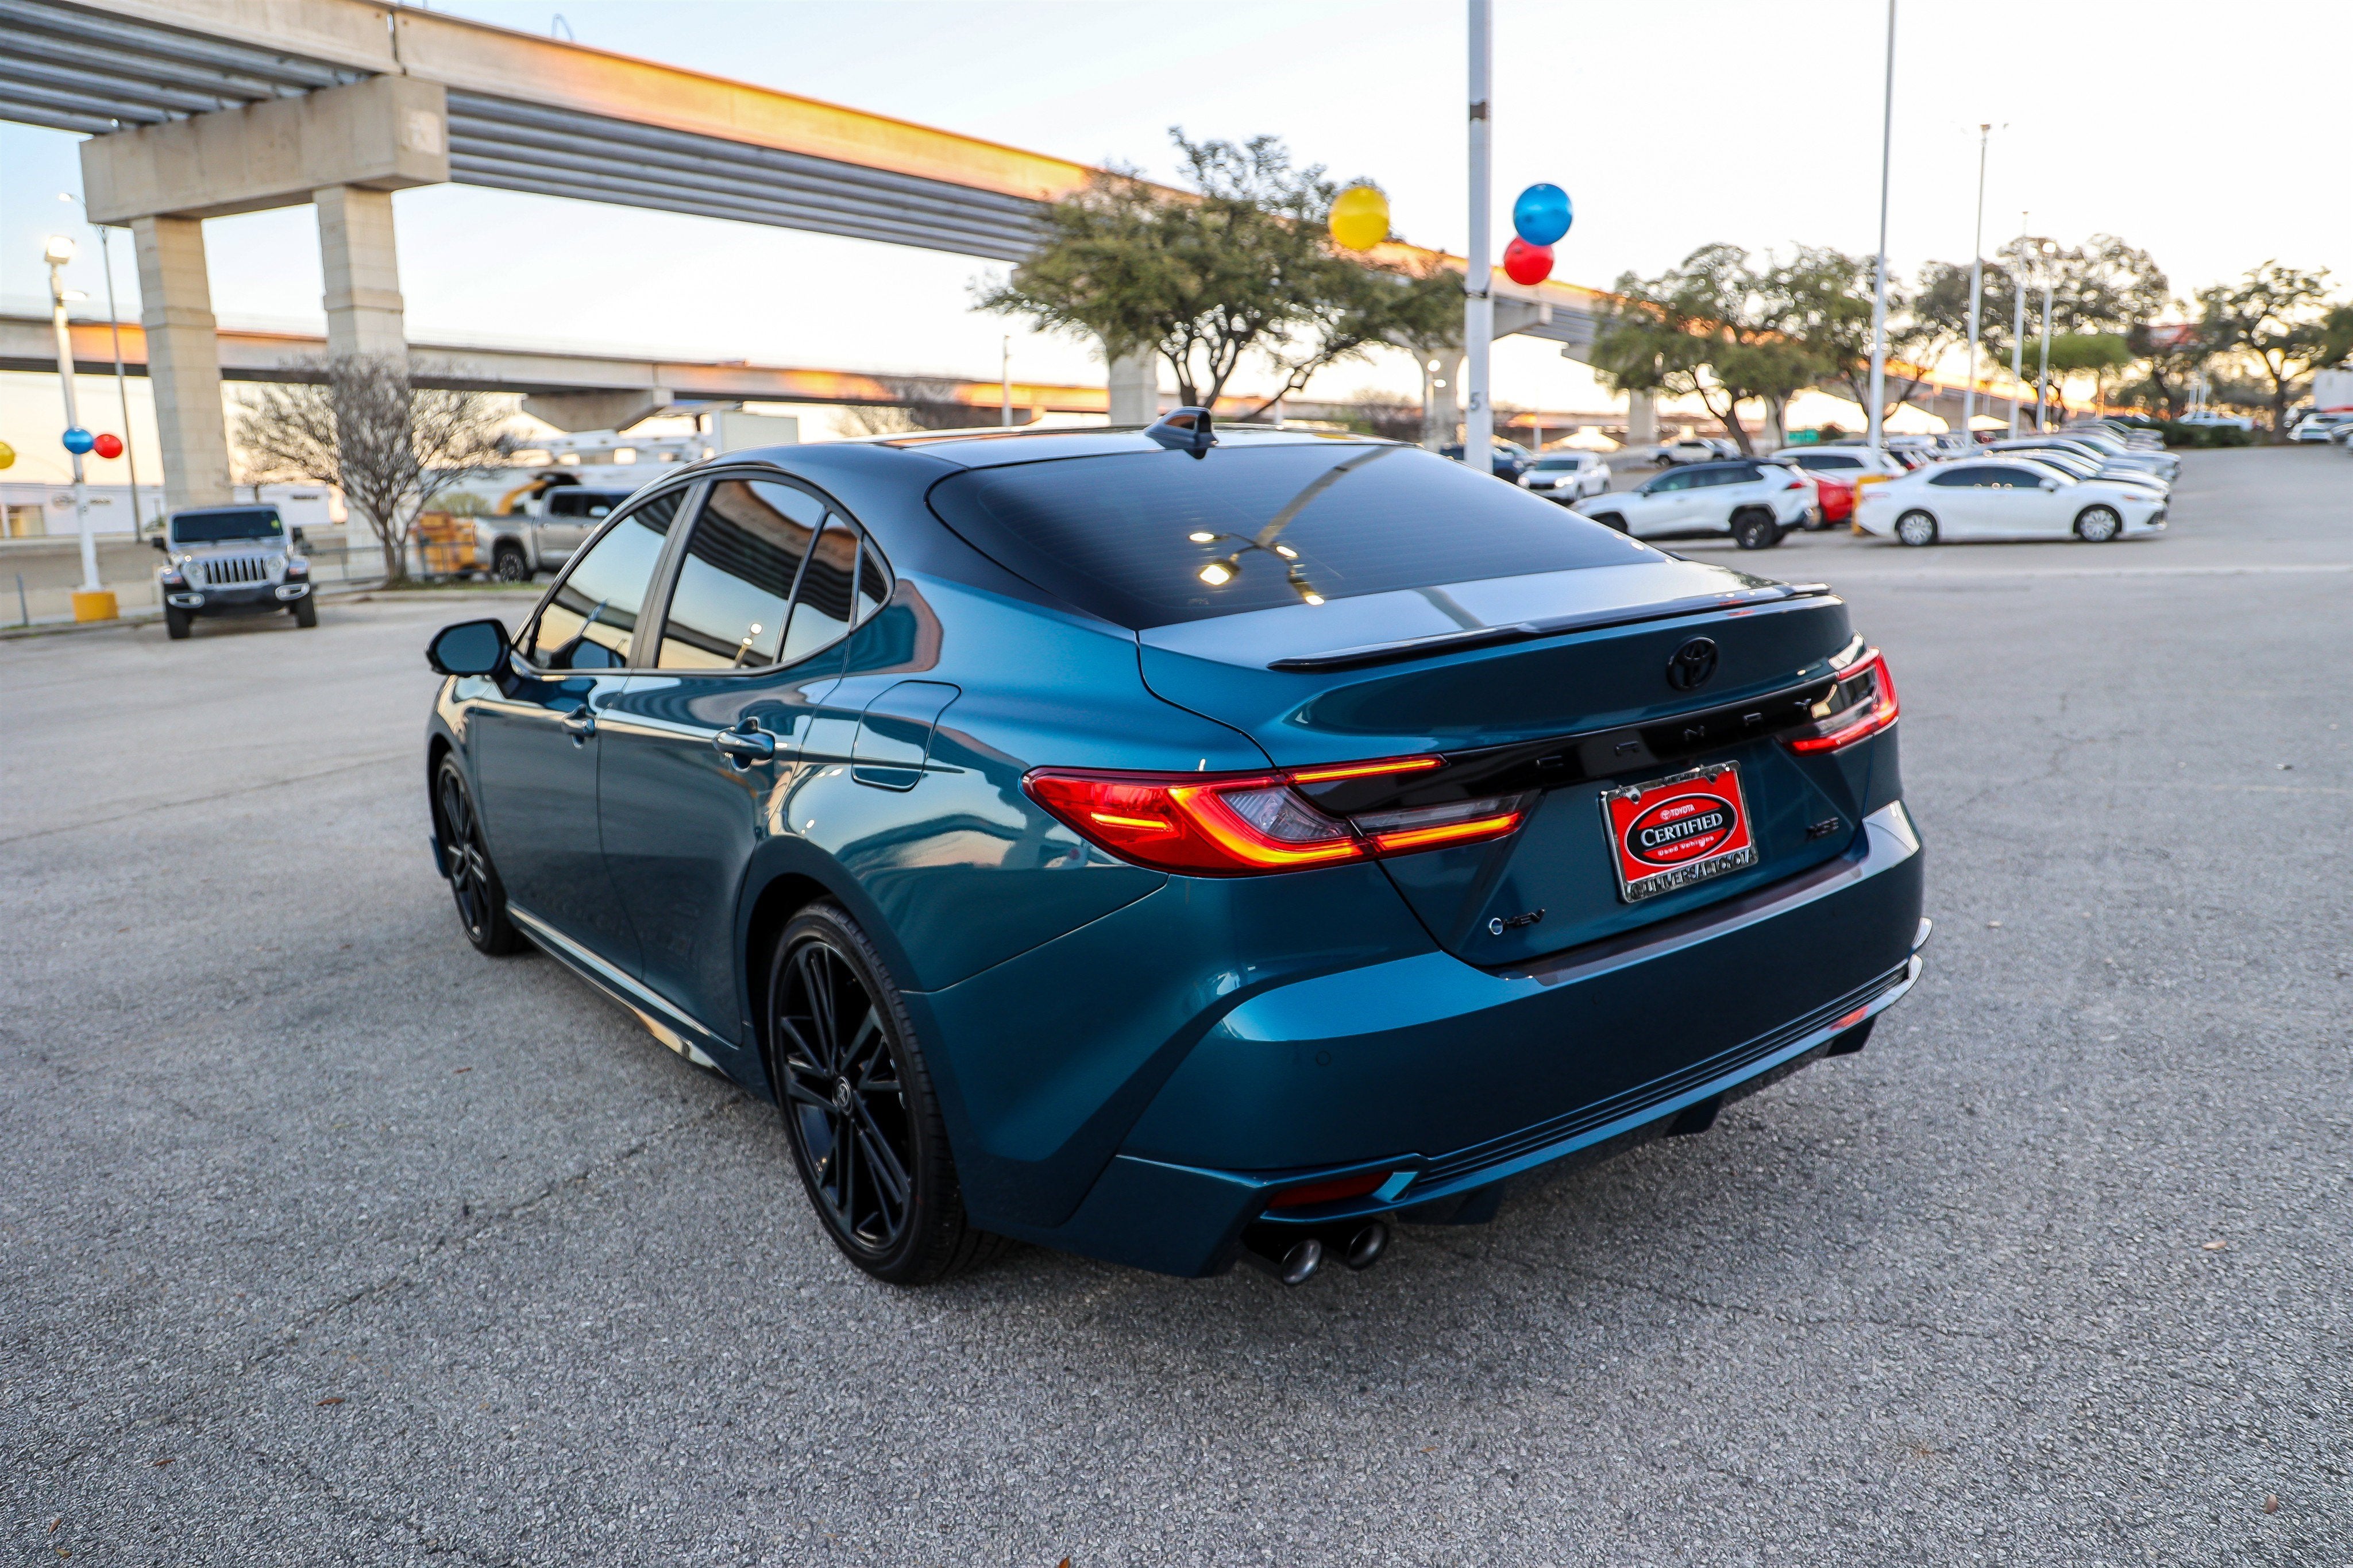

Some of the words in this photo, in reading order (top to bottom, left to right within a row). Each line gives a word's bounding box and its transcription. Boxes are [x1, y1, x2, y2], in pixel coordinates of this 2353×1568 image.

[1470, 392, 1480, 412] 5
[1669, 804, 1695, 817] TOYOTA
[1657, 845, 1678, 856] Used
